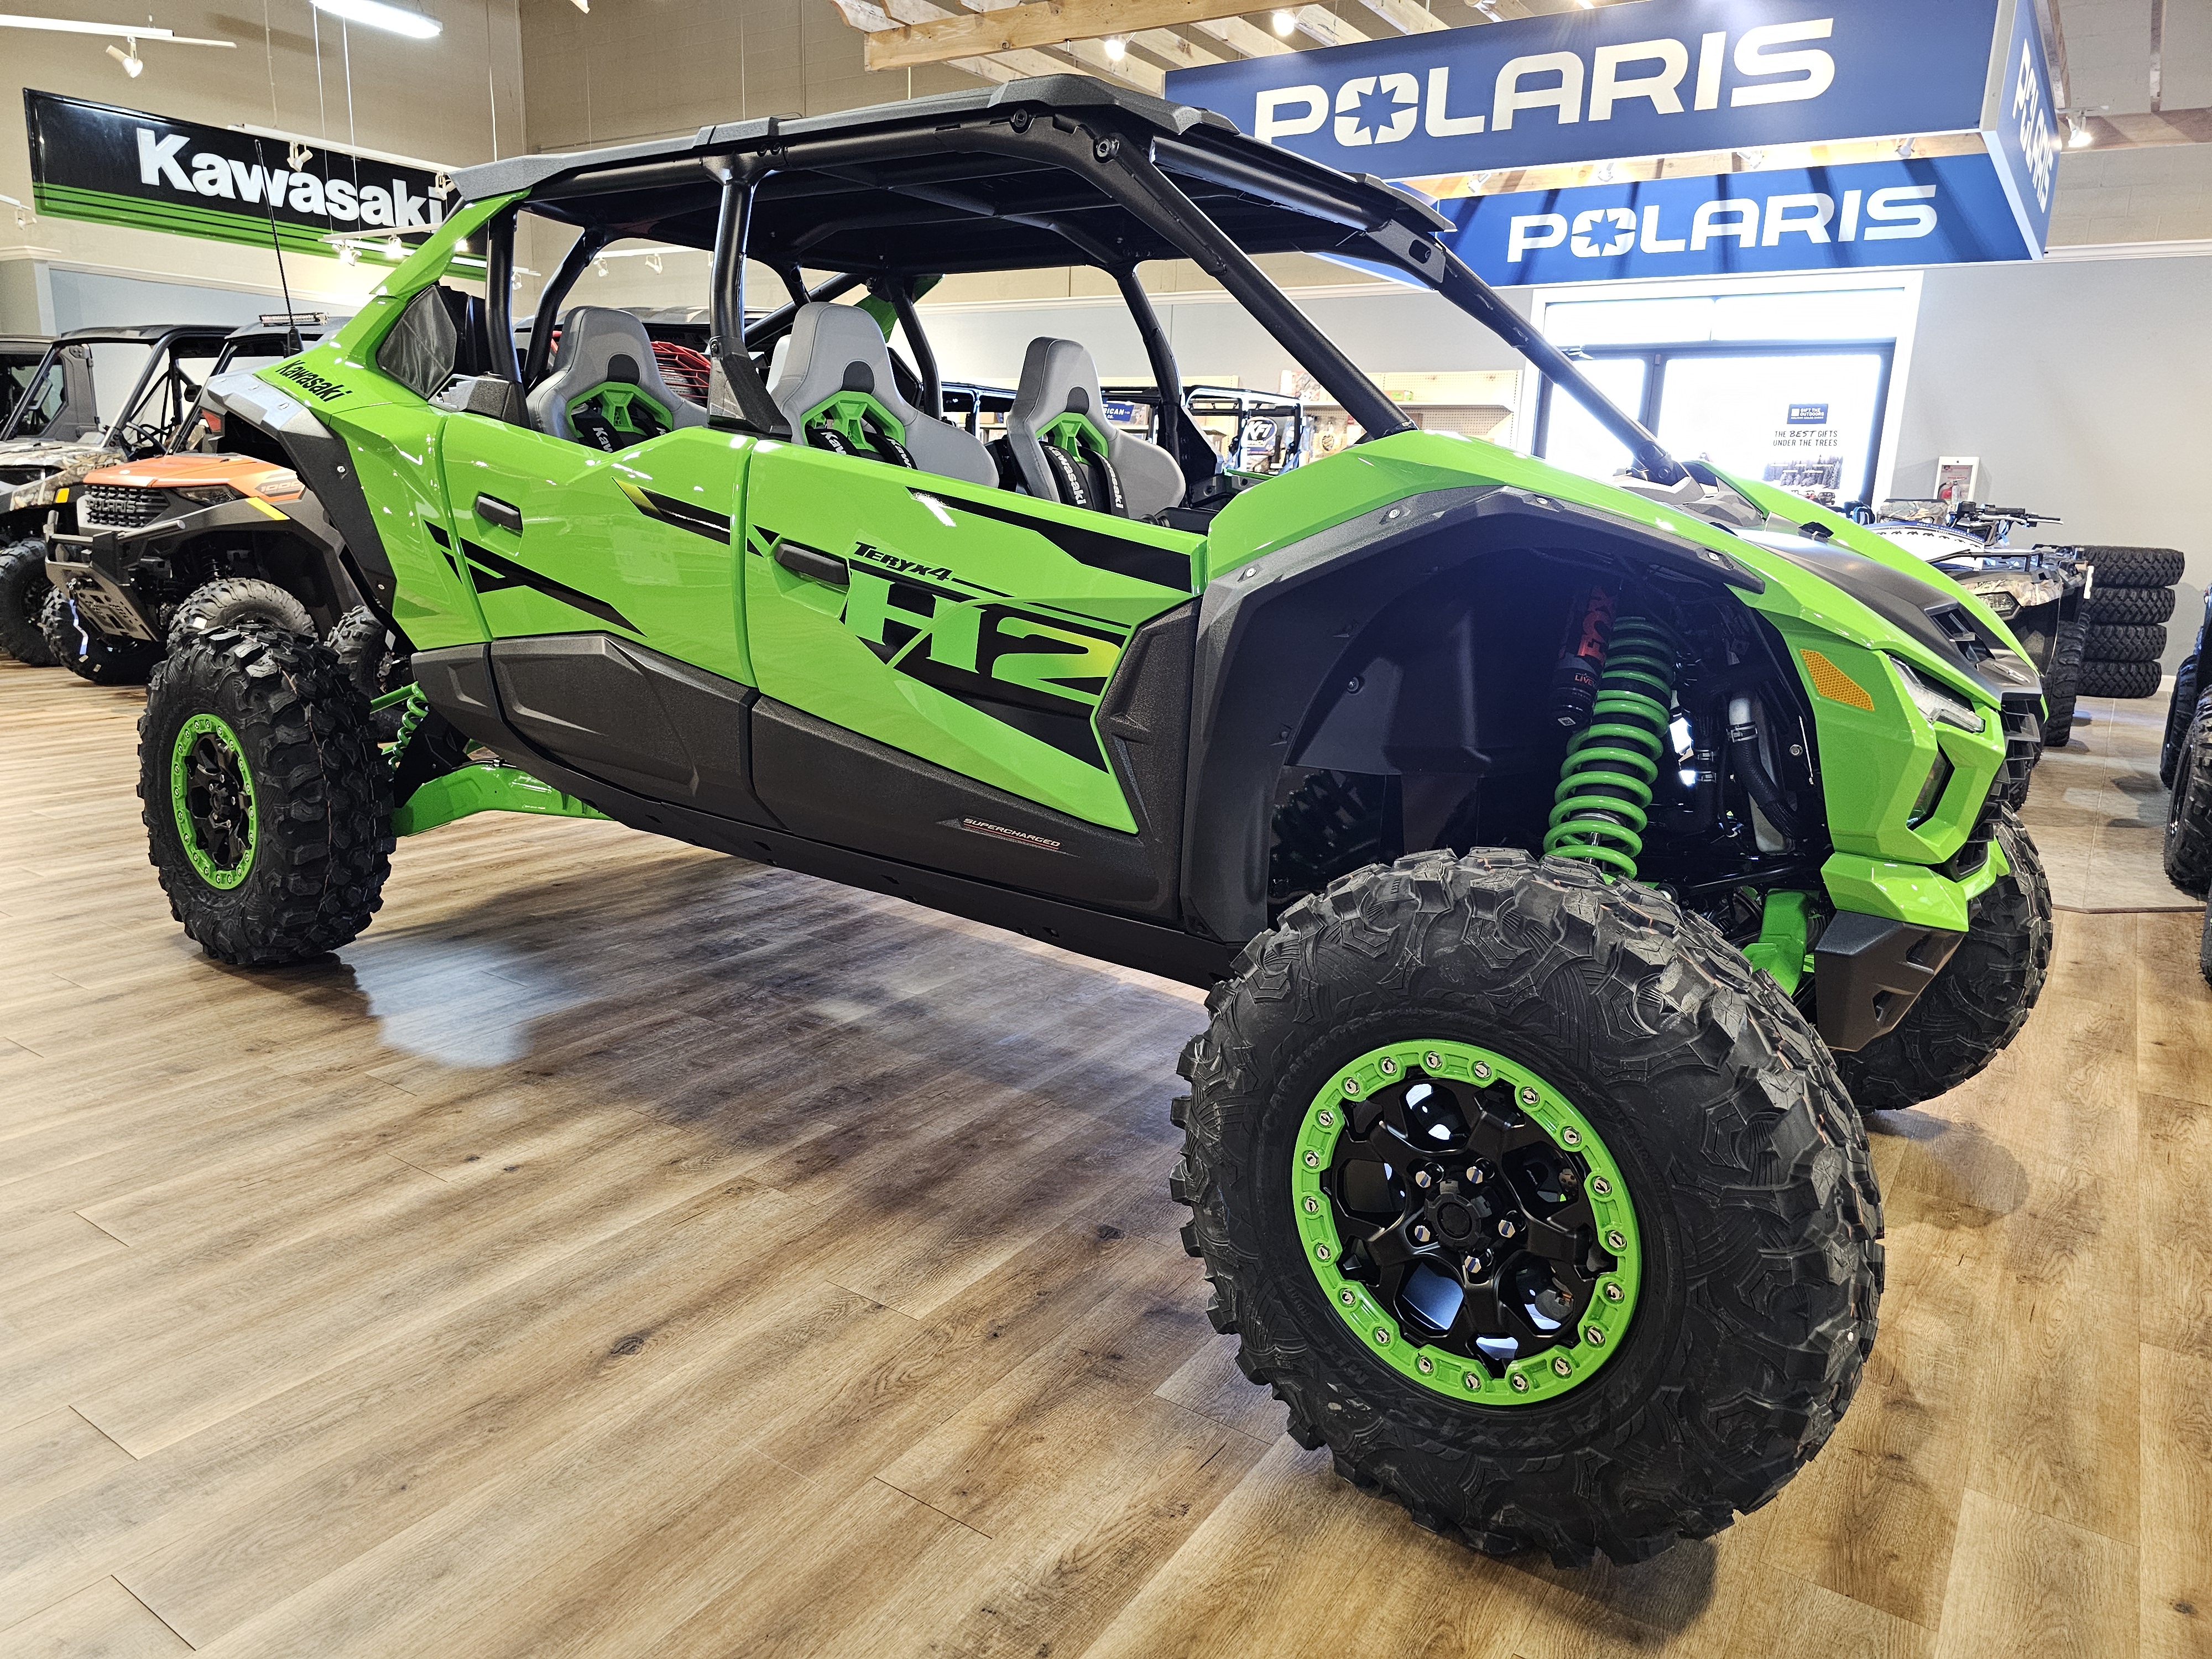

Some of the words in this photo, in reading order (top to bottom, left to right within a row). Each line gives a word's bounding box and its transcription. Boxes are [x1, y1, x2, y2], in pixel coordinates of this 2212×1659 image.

[1254, 18, 1835, 147] POLARIS
[2012, 38, 2054, 214] POLARIS
[136, 127, 444, 233] Kawasaki
[1507, 184, 1938, 263] POLARIS
[275, 359, 353, 402] Kawasaki
[85, 498, 135, 514] POLARIS
[1044, 445, 1087, 505] Kawasaki
[844, 568, 1121, 707] H2
[1577, 586, 1616, 667] FOX
[963, 818, 1061, 847] SUPERCHARGED
